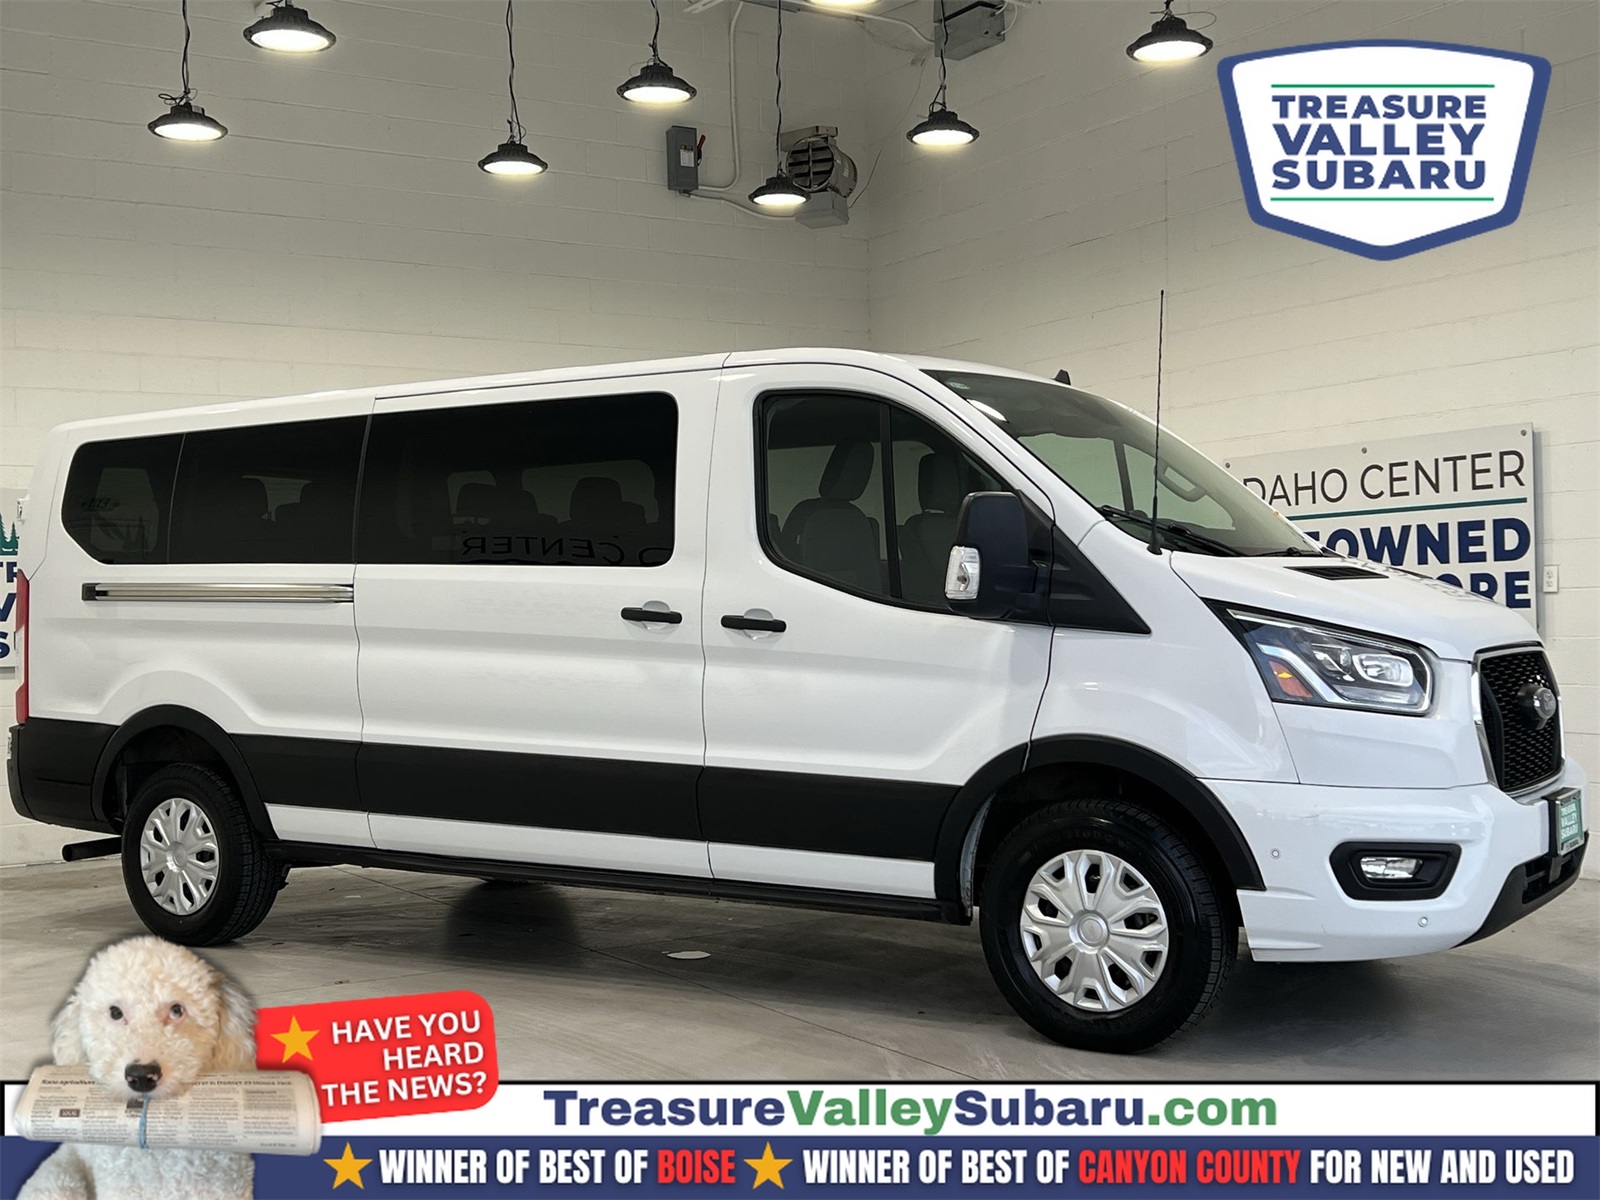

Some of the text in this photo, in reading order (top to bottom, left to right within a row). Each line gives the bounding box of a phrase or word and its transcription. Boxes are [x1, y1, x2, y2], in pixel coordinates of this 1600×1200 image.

[1243, 450, 1525, 506] DAHO CENTER
[1304, 517, 1531, 566] OWNED
